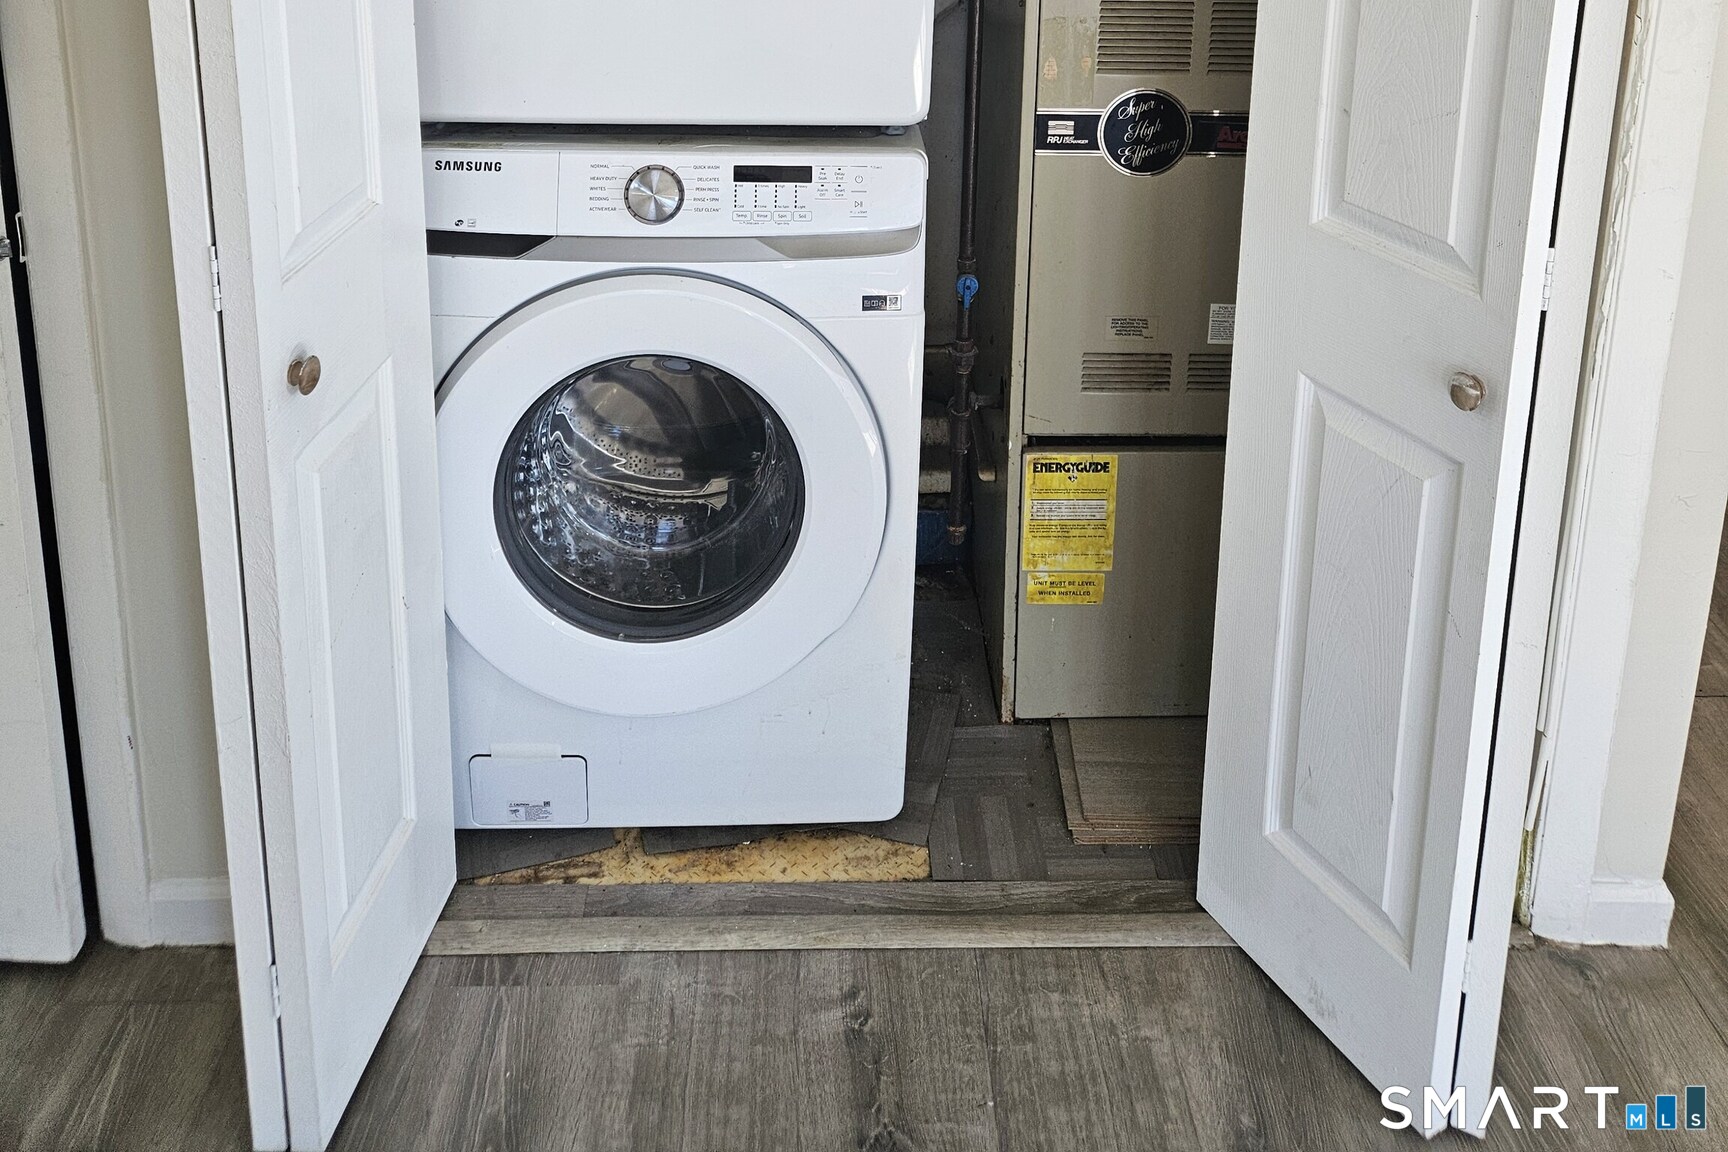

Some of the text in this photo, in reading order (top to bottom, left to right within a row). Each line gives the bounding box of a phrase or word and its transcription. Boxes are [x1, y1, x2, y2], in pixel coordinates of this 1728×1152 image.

[1117, 97, 1156, 121] Super
[1124, 118, 1162, 142] High
[1118, 138, 1180, 167] Efficiency
[434, 160, 502, 172] SAMSUNG
[1033, 461, 1110, 473] ENERGYGUIDE
